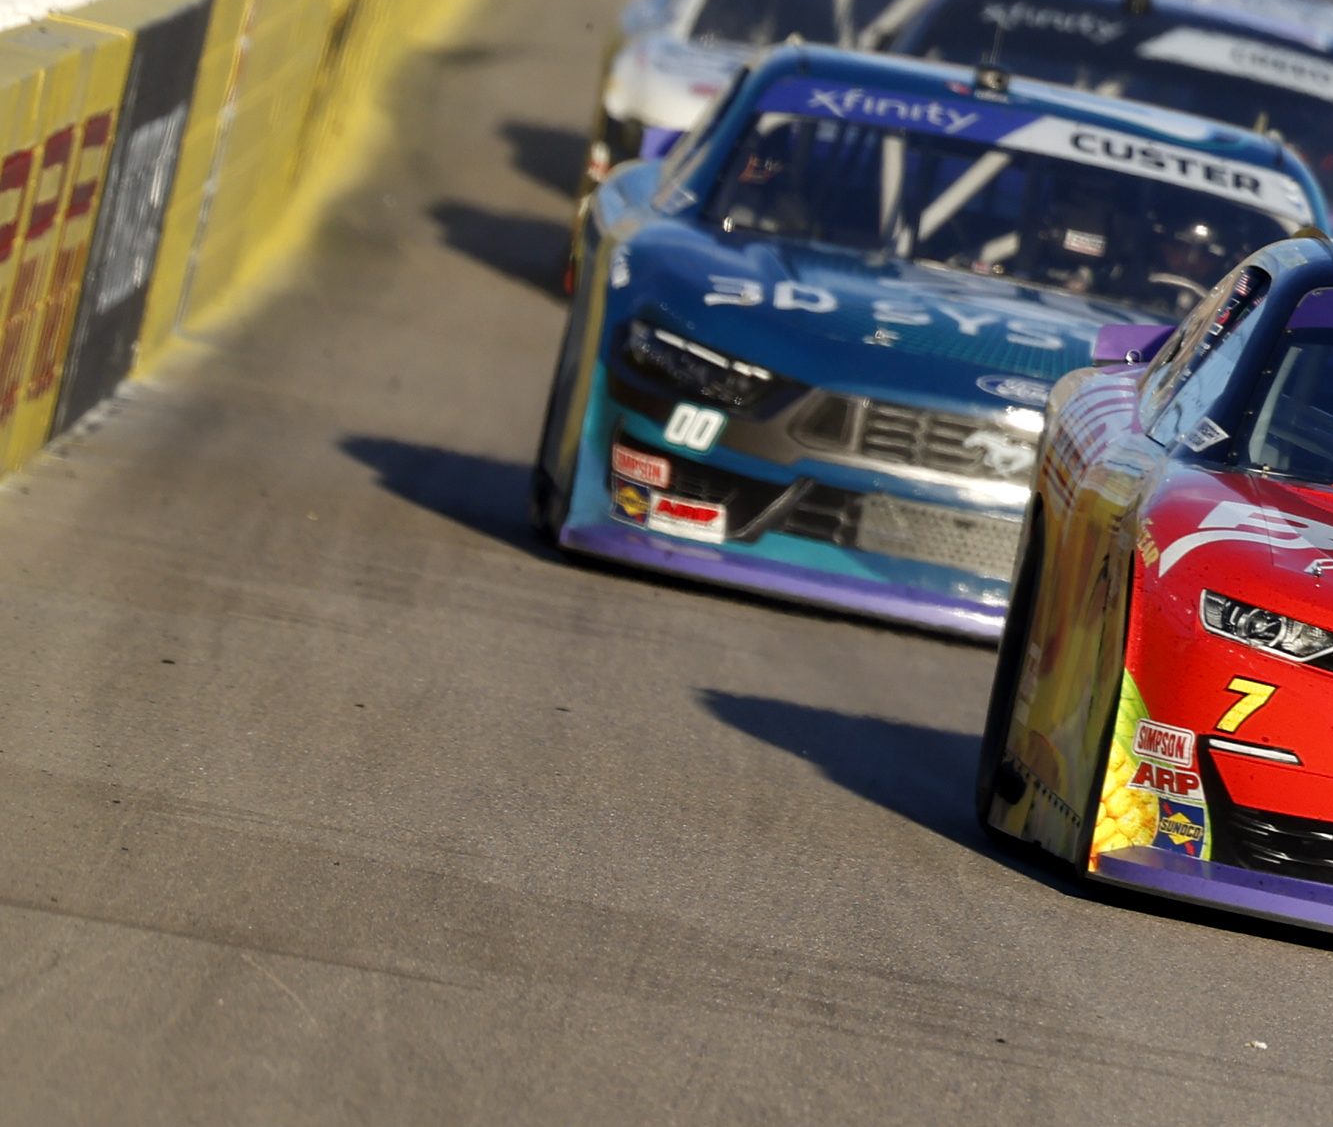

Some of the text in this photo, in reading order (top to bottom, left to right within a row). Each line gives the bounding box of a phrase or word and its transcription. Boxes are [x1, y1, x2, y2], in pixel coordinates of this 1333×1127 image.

[808, 86, 979, 135] xfinity
[1069, 130, 1262, 198] CUSTER
[704, 275, 838, 314] 3D
[664, 403, 725, 452] 00
[1215, 676, 1280, 734] 7
[1138, 725, 1187, 759] SIMPSON
[1132, 762, 1200, 796] ARP
[1160, 818, 1204, 839] SUNOCO
